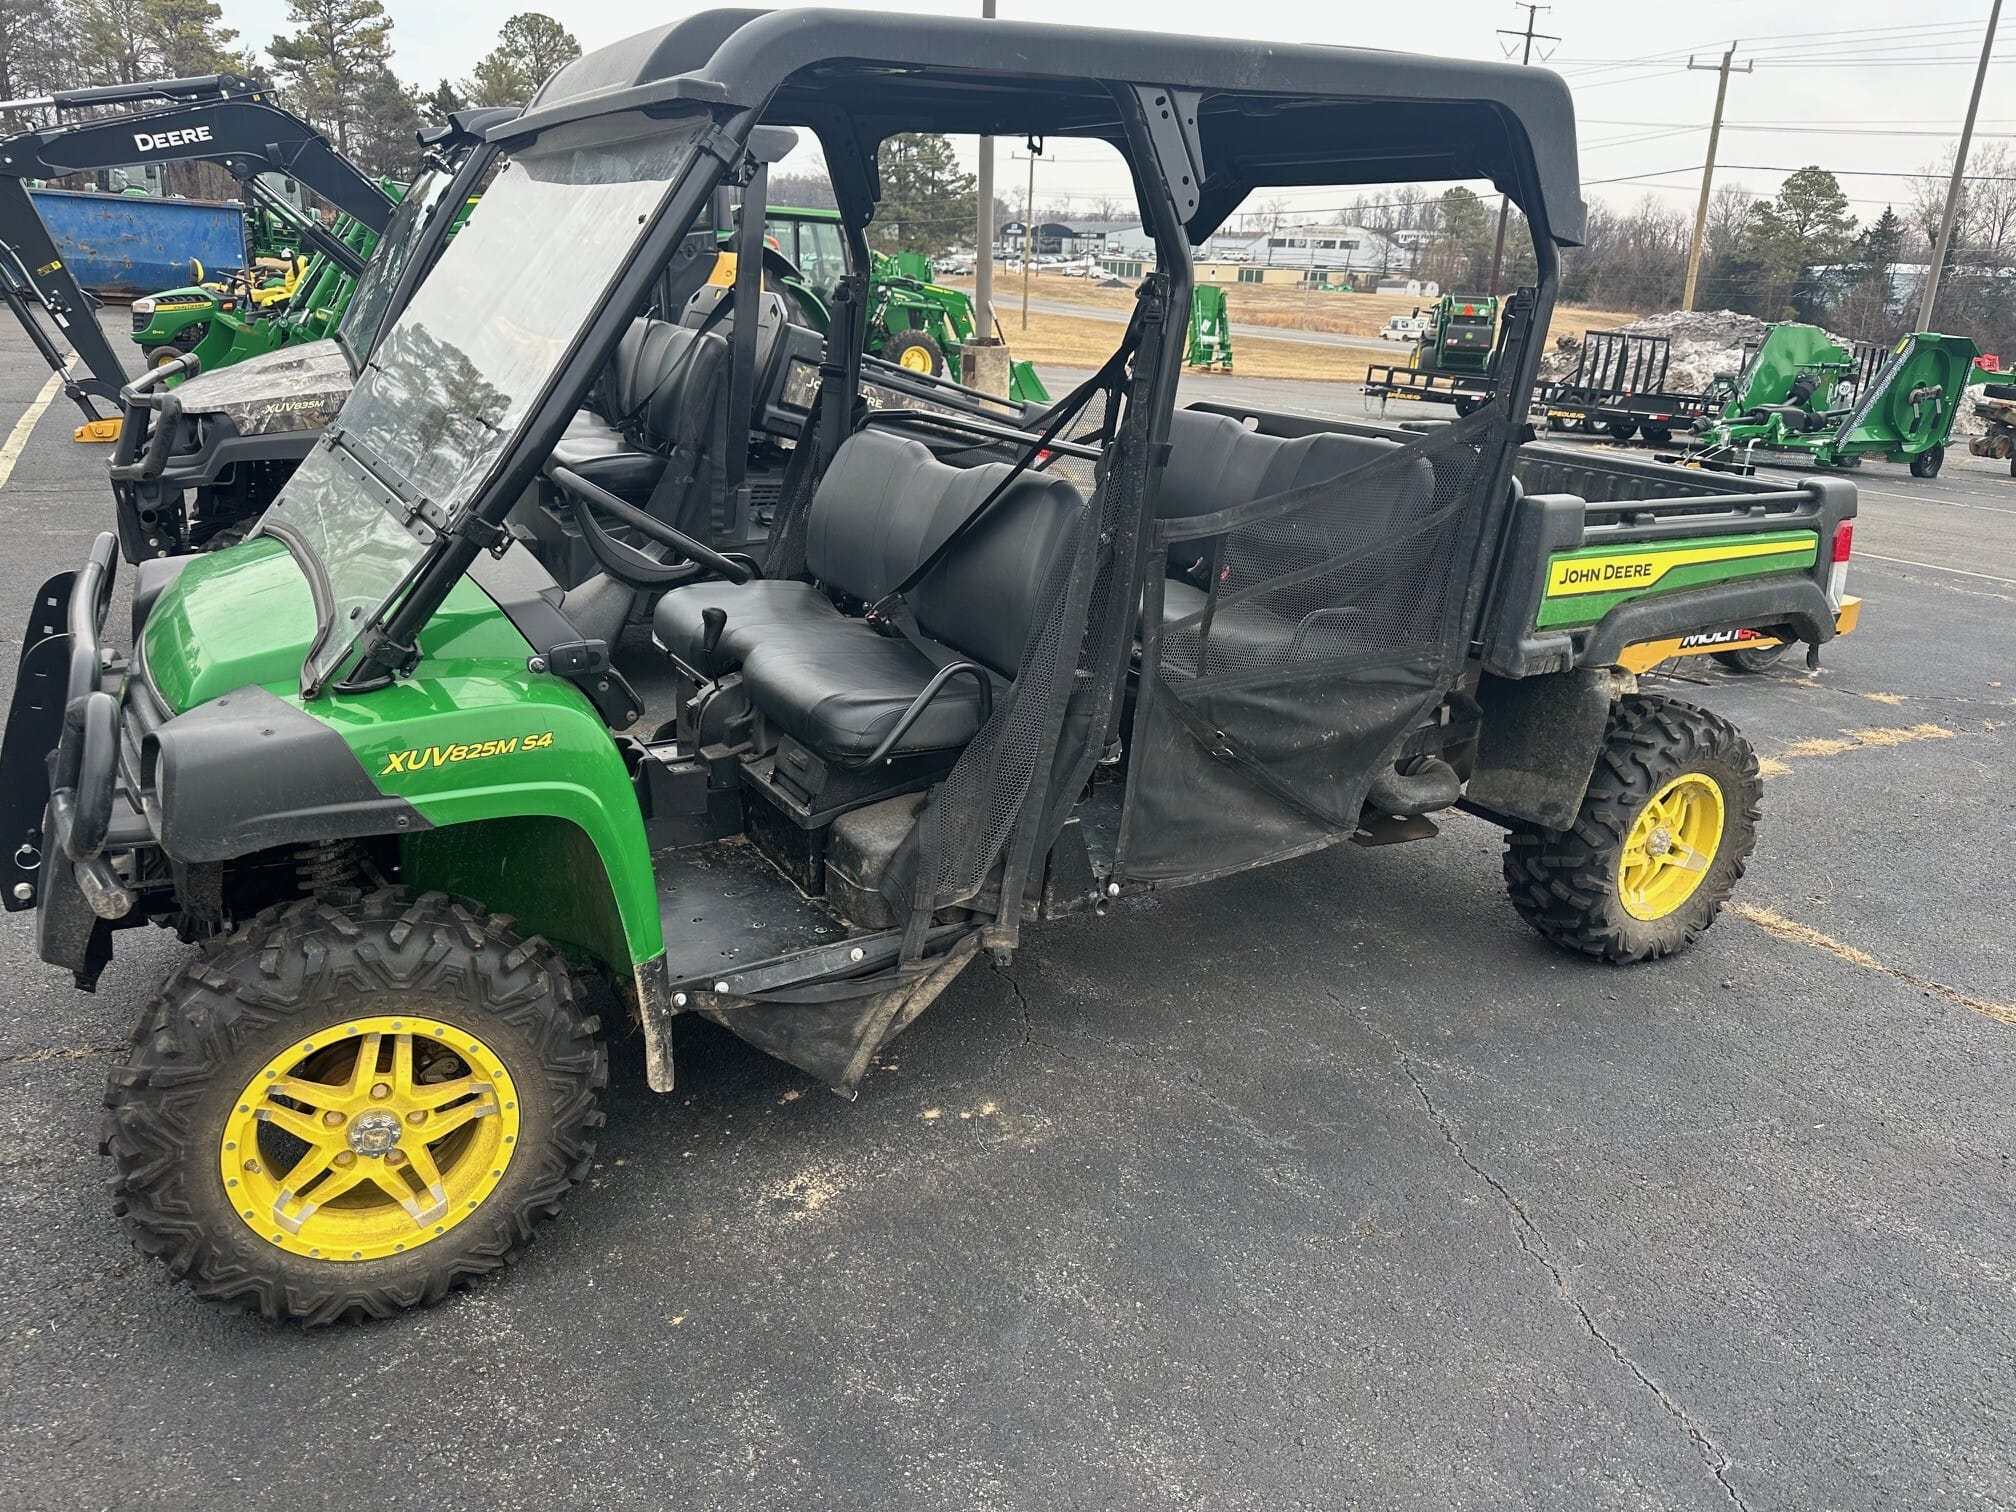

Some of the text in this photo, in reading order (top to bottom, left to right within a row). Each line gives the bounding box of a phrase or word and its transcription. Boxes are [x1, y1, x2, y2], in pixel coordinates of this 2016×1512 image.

[133, 126, 213, 152] DEERE
[1841, 384, 1850, 392] 20
[261, 400, 324, 415] XUV835M
[1559, 563, 1652, 585] JOHN DEERE
[377, 732, 554, 777] XUV825M S4
